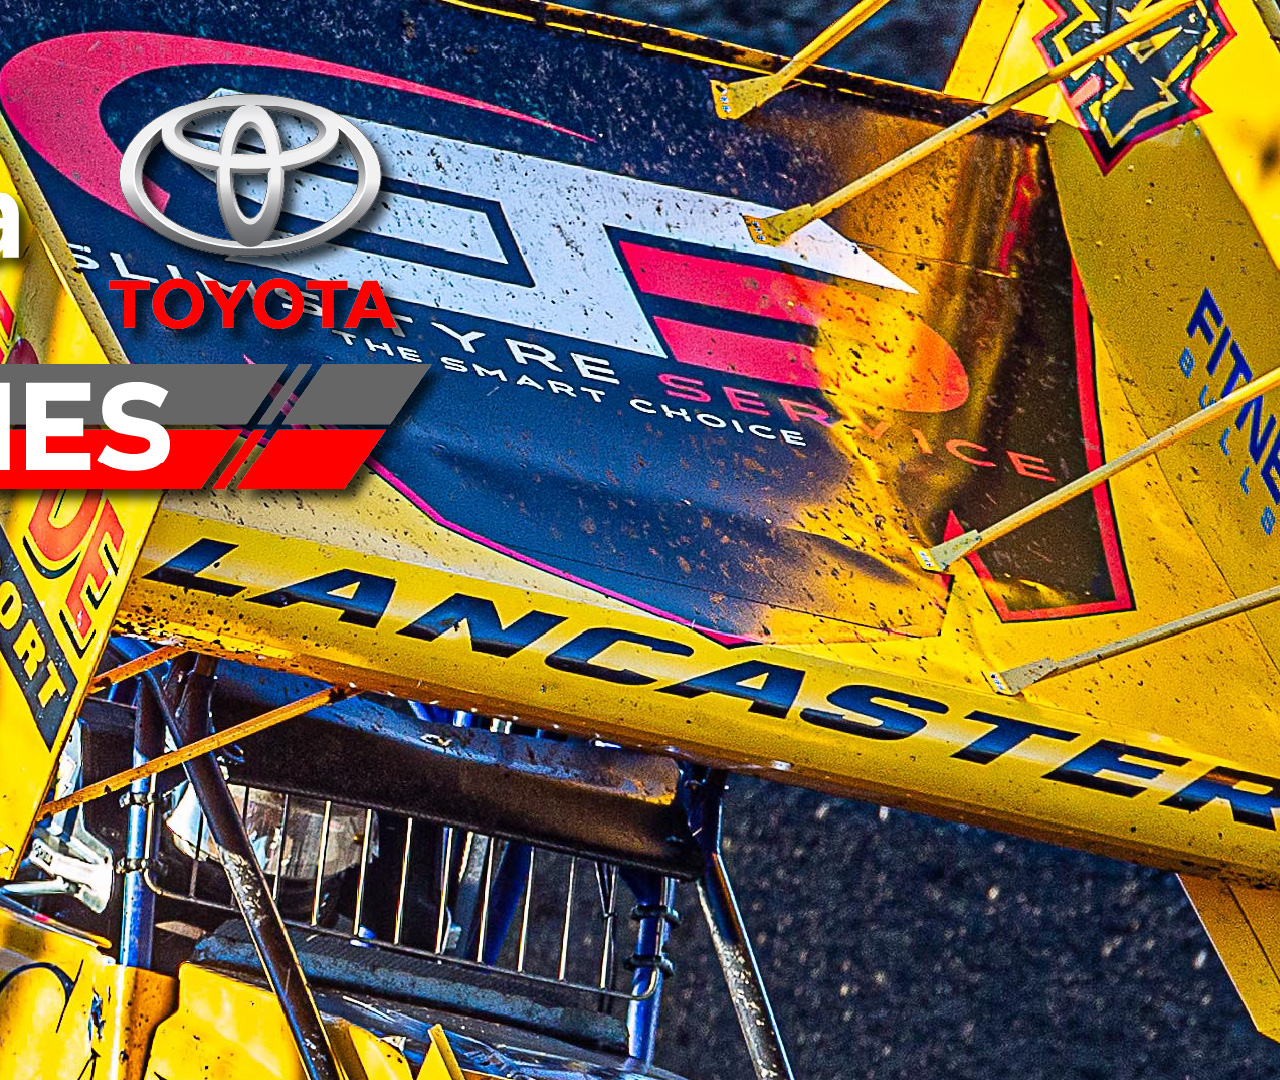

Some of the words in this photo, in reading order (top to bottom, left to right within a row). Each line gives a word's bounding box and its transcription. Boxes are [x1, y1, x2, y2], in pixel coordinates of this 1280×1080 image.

[331, 329, 423, 363] THE
[439, 356, 621, 405] SMART
[628, 399, 807, 448] CHOICE
[658, 372, 1057, 483] SERVICE
